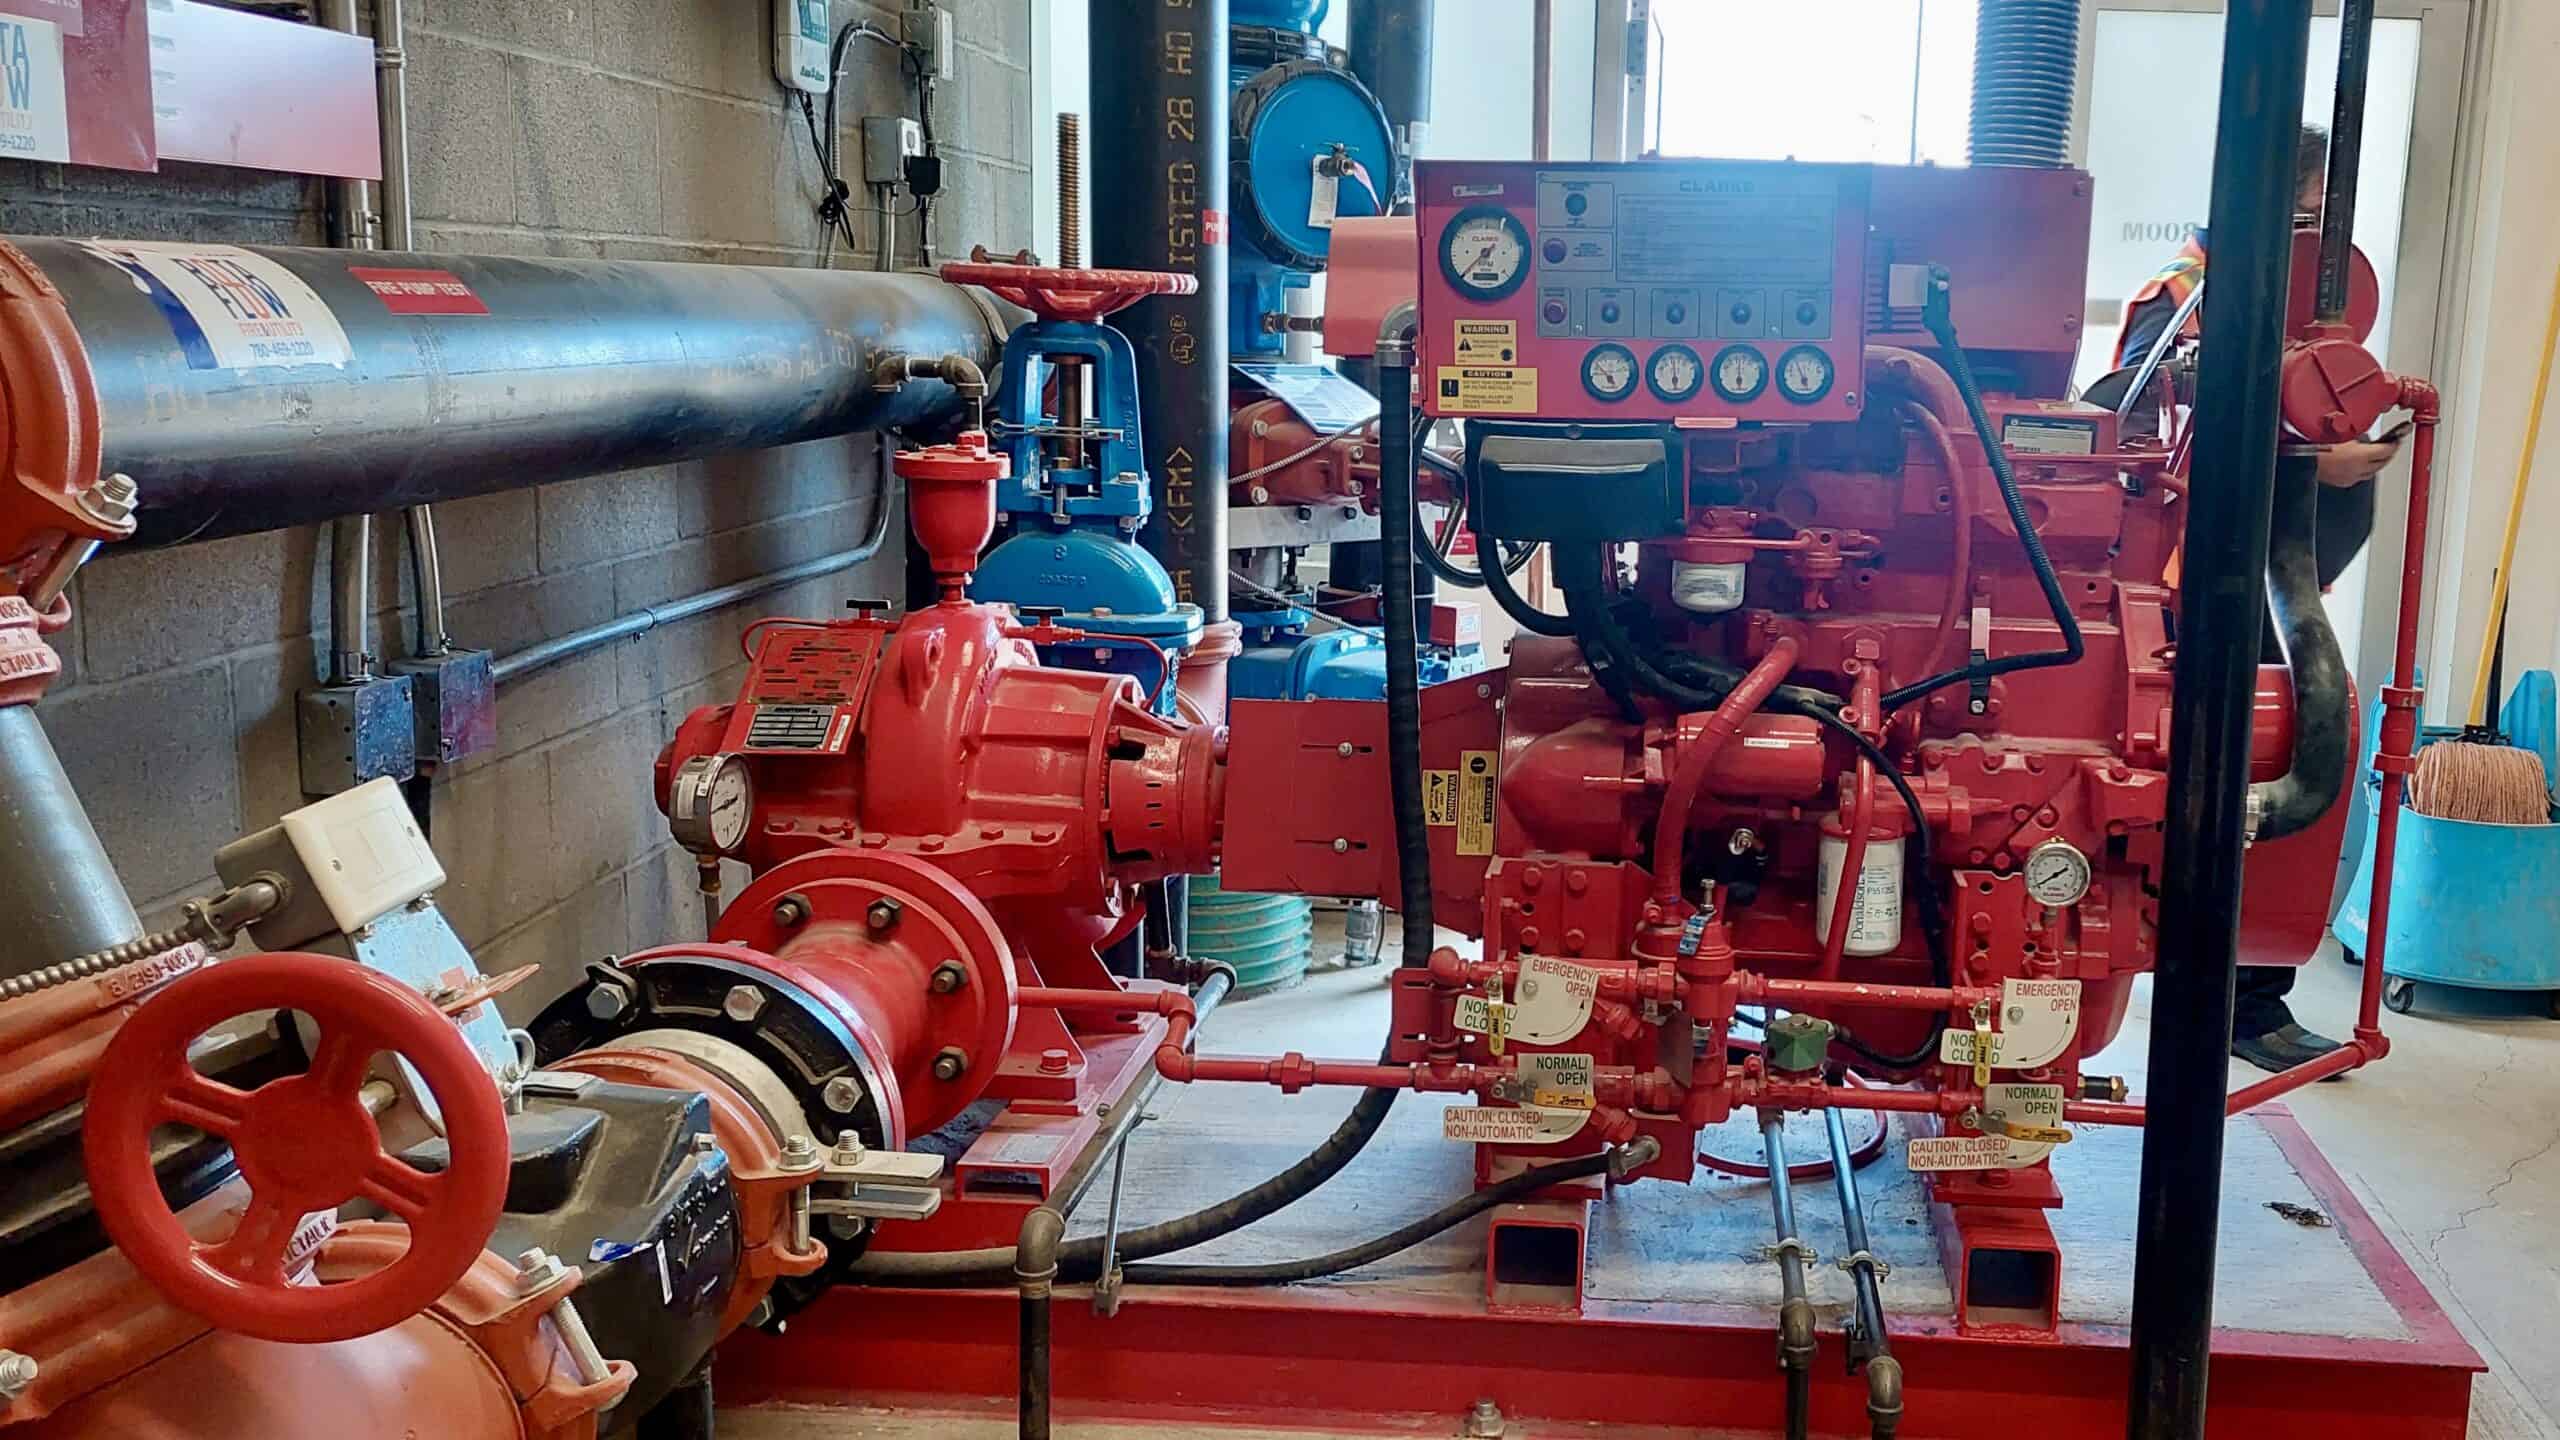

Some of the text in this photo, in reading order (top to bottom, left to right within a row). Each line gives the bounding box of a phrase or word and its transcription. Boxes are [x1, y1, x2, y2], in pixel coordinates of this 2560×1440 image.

[1166, 97, 1194, 141] 28
[1167, 162, 1195, 265] ISTED
[365, 280, 472, 296] FIRE PUMP TEST
[1462, 325, 1507, 334] WARNING
[1466, 370, 1507, 378] CAUTION
[1447, 775, 1457, 821] WARNING
[1485, 779, 1493, 819] CAUTION
[1532, 959, 1596, 982] EMERGENCY/
[1565, 981, 1593, 998] OPEN
[2016, 983, 2079, 997] EMERGENCY/
[2050, 999, 2077, 1012] OPEN
[1464, 1014, 1511, 1035] CLOD
[1536, 1056, 1588, 1070] NORMAL/
[1951, 1048, 2000, 1065] CLOD
[1556, 1071, 1588, 1086] OPEN
[2005, 1087, 2059, 1100] NORMAL/
[1445, 1109, 1544, 1124] CAUTION: CLOSED/
[2024, 1102, 2058, 1115] OPEN
[1445, 1124, 1534, 1140] NON-AUTOMATIC
[1911, 1138, 2010, 1155] CAUTION: CLOSED/
[1910, 1152, 2000, 1168] NON-AUTOMATIC
